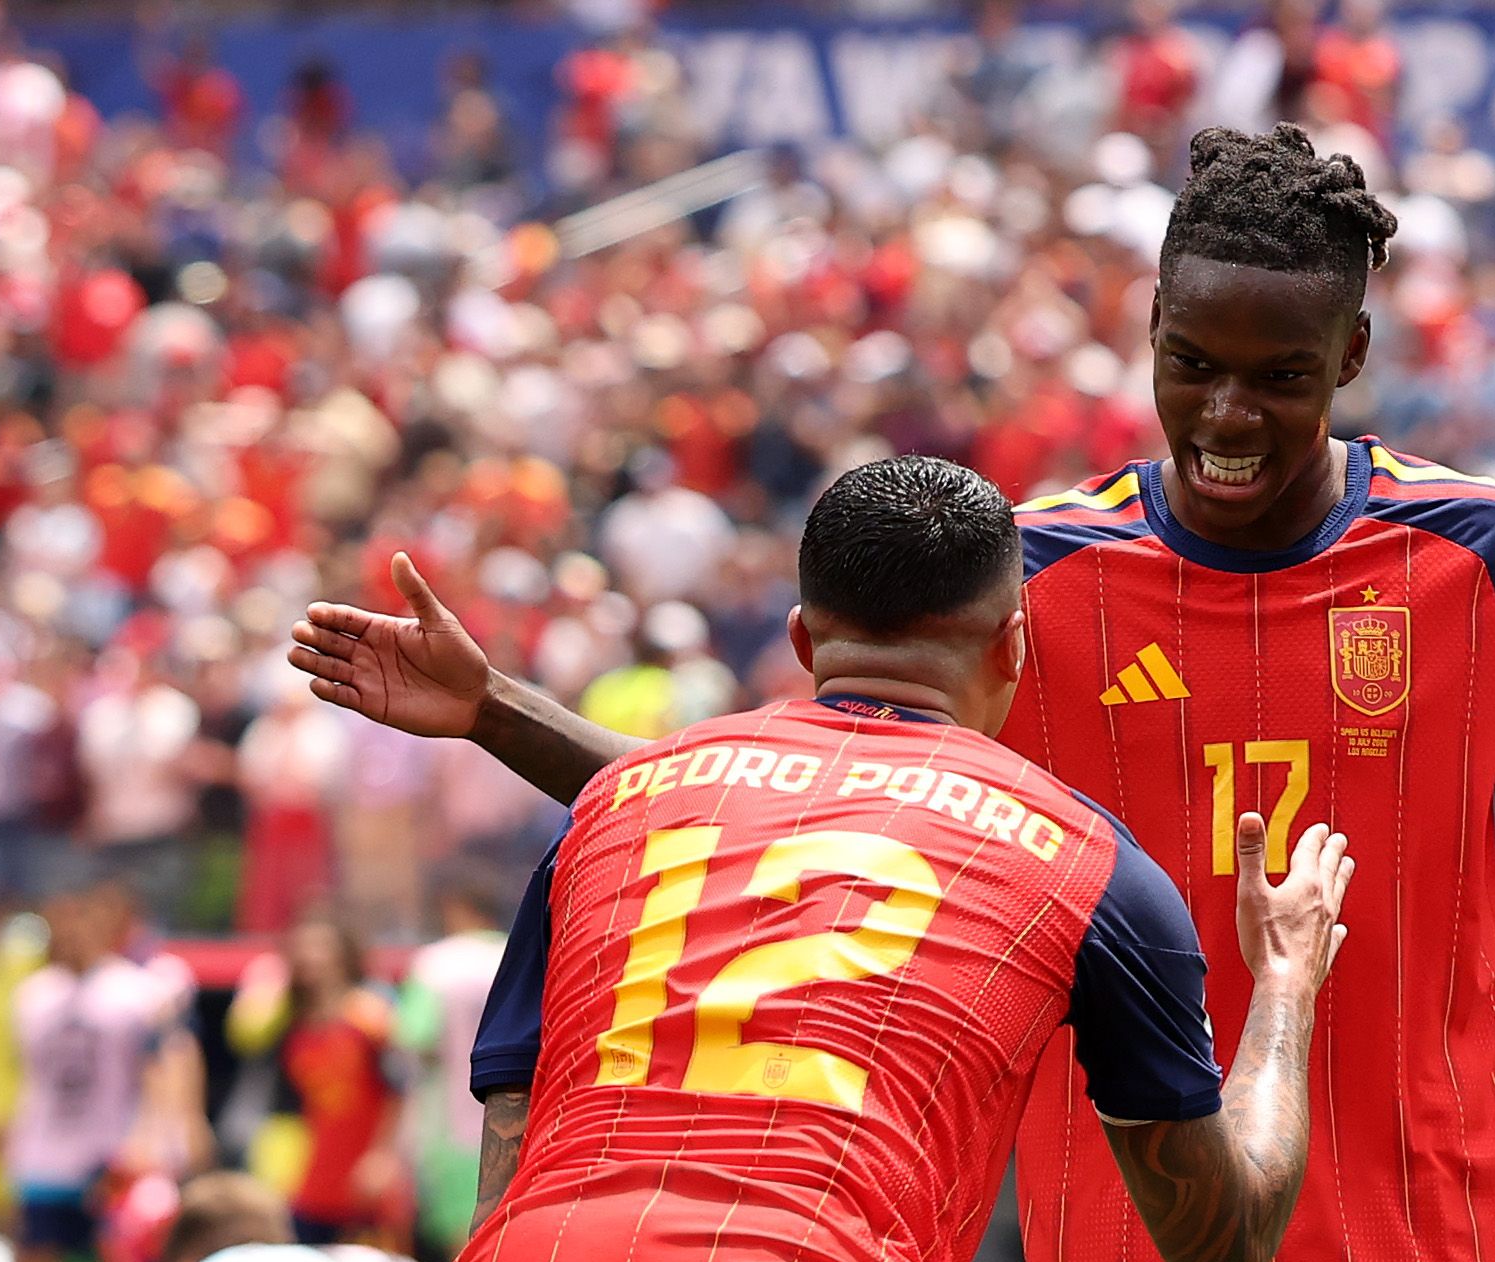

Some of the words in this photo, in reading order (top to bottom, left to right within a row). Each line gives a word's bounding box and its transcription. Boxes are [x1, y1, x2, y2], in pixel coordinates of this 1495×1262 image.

[1340, 727, 1359, 736] SPAIN
[1347, 747, 1360, 756] LOS
[1361, 747, 1388, 757] ANGELES
[1357, 738, 1371, 746] JULY
[609, 746, 822, 811] PEDRO
[836, 762, 1066, 862] PORRO
[1204, 739, 1310, 876] 17
[595, 825, 943, 1113] 12
